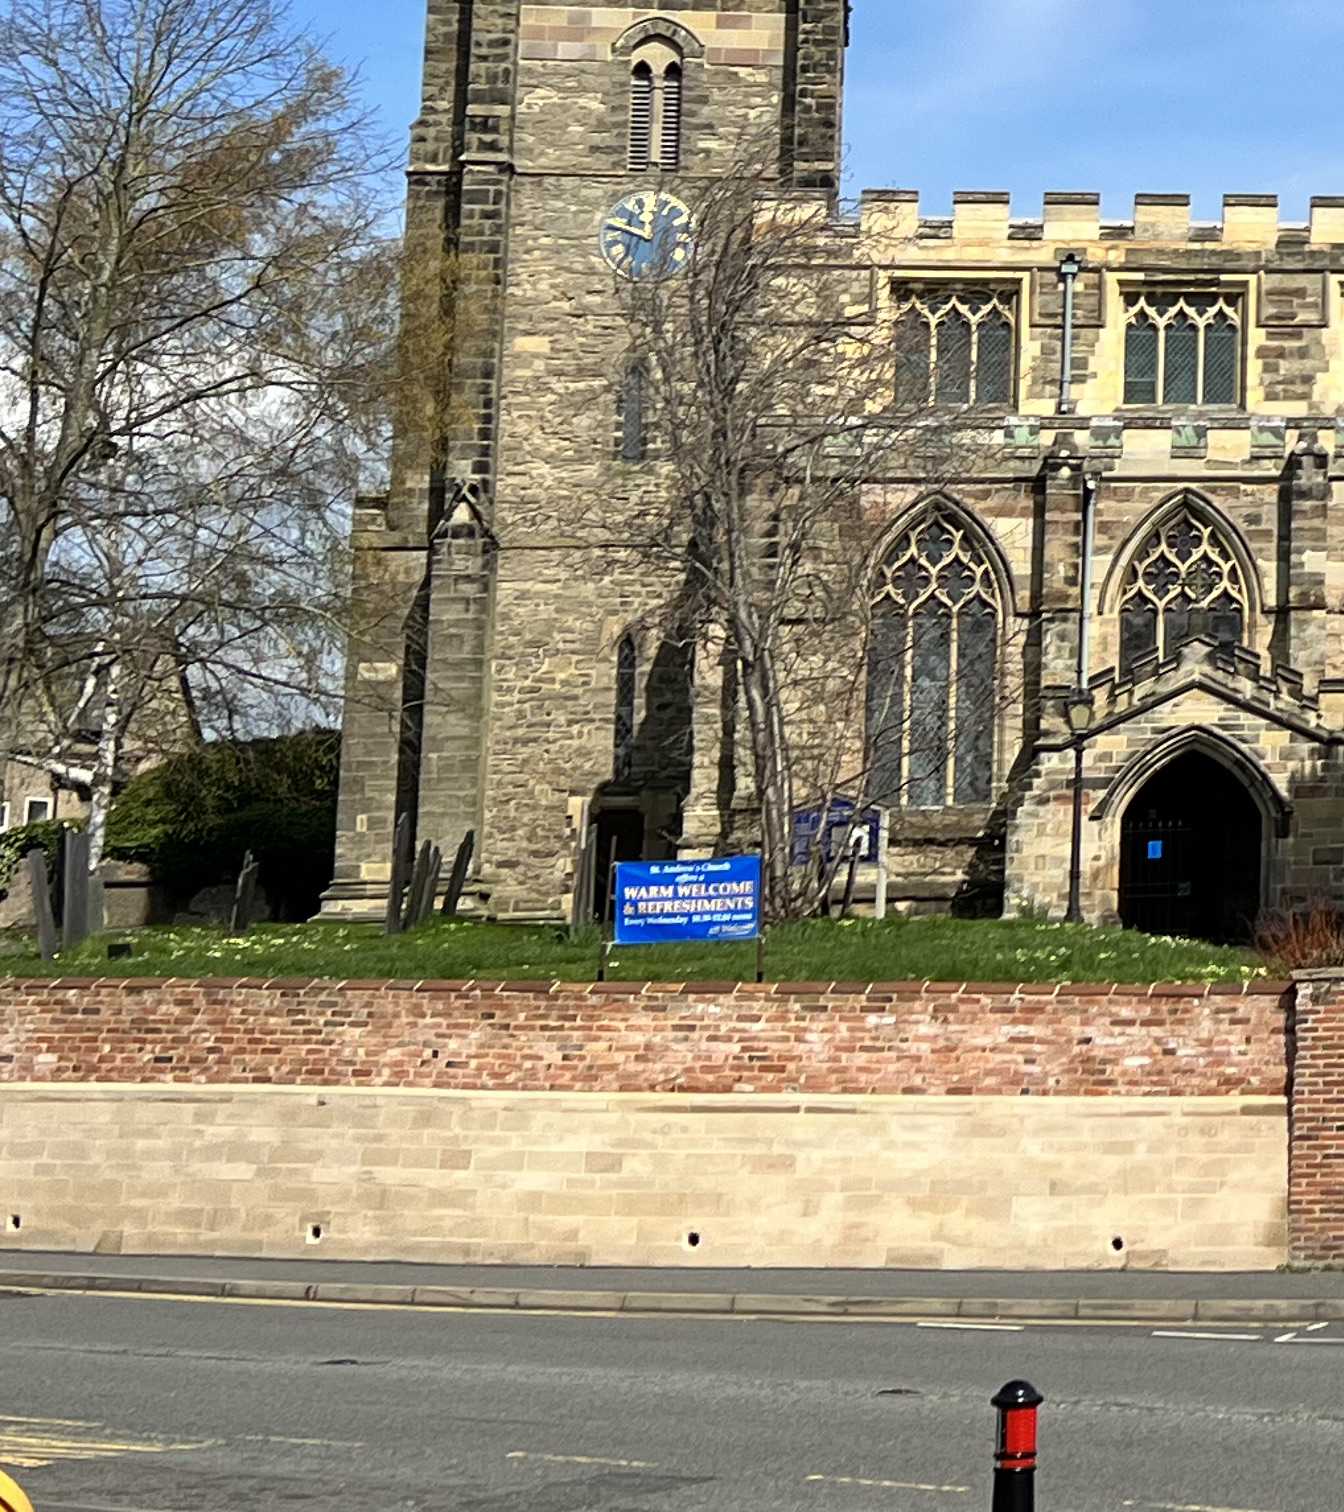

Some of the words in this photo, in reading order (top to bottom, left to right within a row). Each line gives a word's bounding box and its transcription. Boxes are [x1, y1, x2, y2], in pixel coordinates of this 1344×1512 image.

[624, 885, 674, 899] WARM
[677, 881, 753, 897] WELCOME
[623, 901, 635, 916] &
[637, 897, 753, 913] REFRESHMENTS
